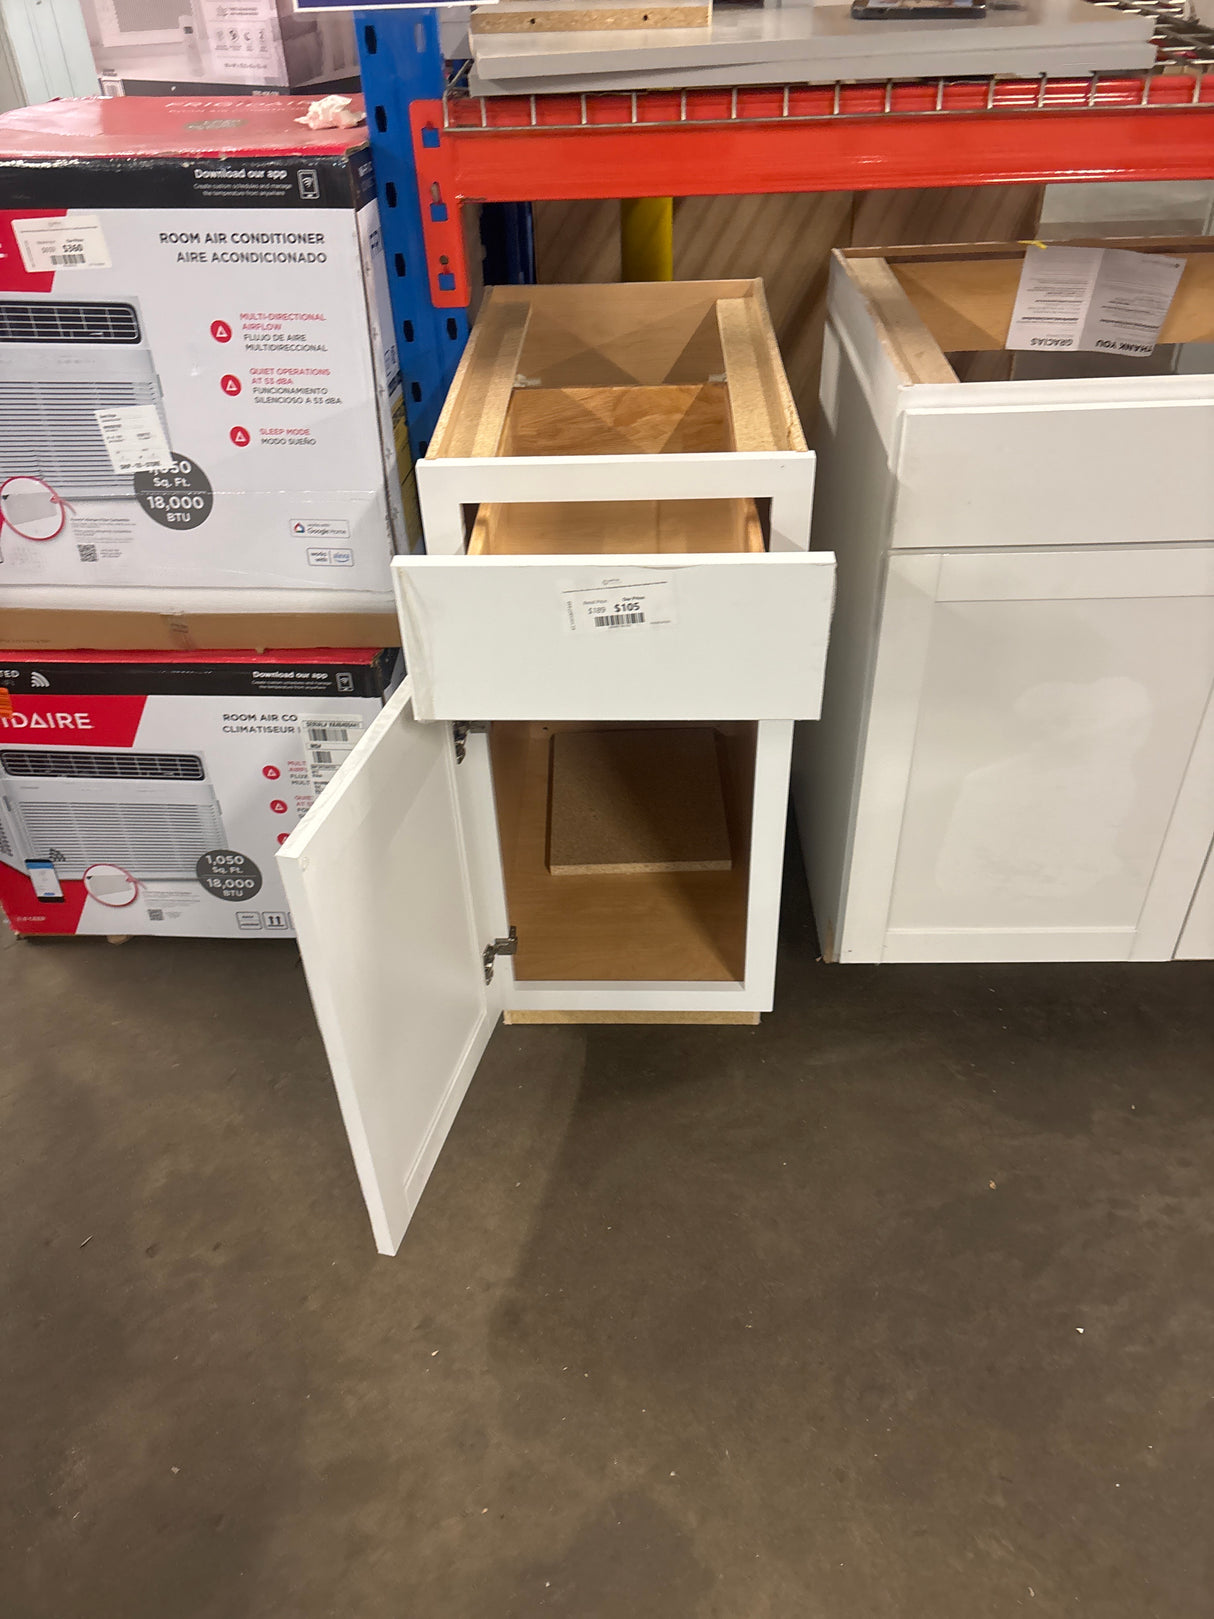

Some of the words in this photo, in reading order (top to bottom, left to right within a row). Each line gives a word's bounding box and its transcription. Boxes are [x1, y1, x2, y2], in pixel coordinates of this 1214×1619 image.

[194, 168, 246, 178] Download
[247, 170, 265, 178] our
[266, 170, 288, 180] app
[159, 232, 200, 244] ROOM
[204, 232, 228, 244] AIR
[230, 232, 325, 244] CONDITIONER
[176, 252, 208, 263] AIRE
[211, 252, 328, 264] ACONDICIONADO
[240, 312, 326, 321] MULTI-DIRECTIONAL
[244, 334, 271, 342] FLUJO
[1030, 338, 1074, 347] GRACIAS
[246, 344, 328, 352] MULTIDIRECCIONAL
[1096, 340, 1117, 350] YOU
[1118, 342, 1153, 352] THANK
[276, 368, 331, 376] OPERATIONS
[252, 387, 328, 395] FUNCIONAMIENTO
[261, 438, 287, 446] MODO
[146, 496, 204, 512] 18,000
[166, 512, 191, 522] BTU
[614, 602, 641, 613] $105
[252, 671, 294, 679] Download
[222, 714, 256, 722] ROOM
[260, 714, 278, 722] AIR
[222, 726, 295, 734] CLIMATISEUR
[206, 854, 244, 866] 1,050
[206, 878, 255, 890] 18,000
